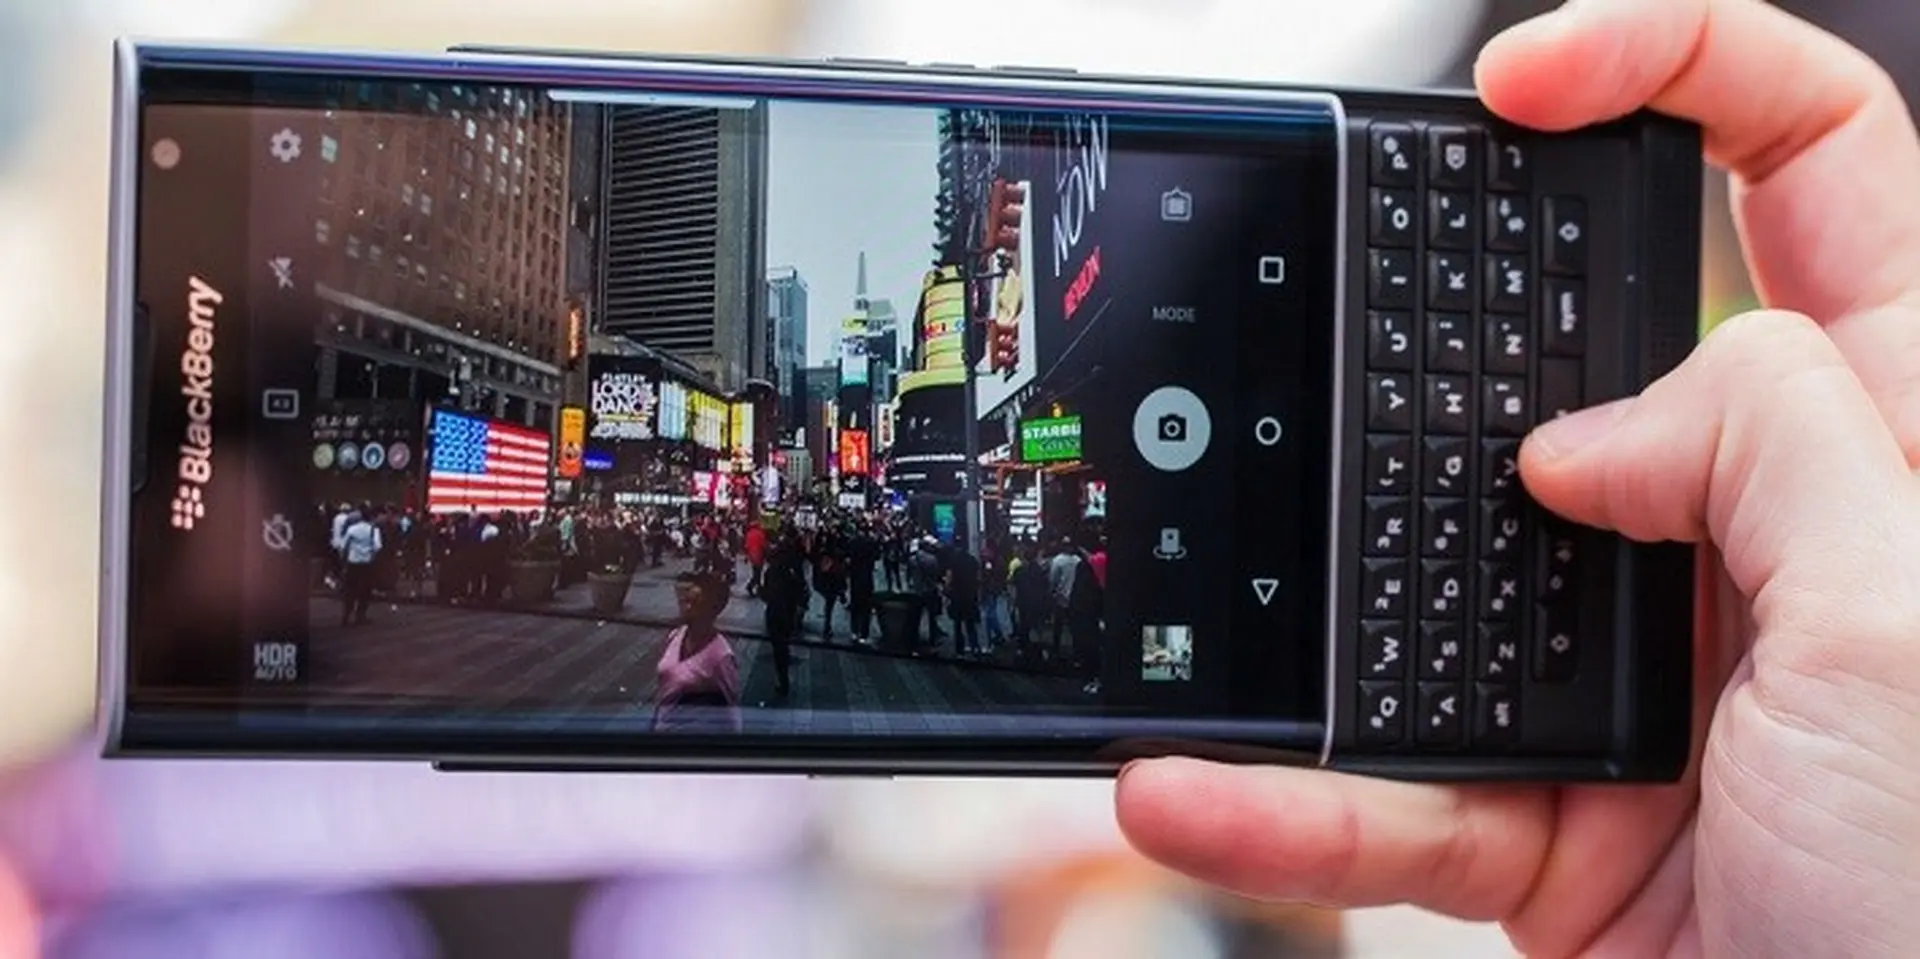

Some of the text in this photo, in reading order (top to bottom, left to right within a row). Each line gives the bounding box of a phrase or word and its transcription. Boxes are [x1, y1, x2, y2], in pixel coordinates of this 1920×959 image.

[1392, 154, 1408, 169] P
[1053, 115, 1108, 277] NOW
[1392, 207, 1409, 229] O
[1450, 214, 1465, 228] L
[1391, 276, 1406, 284] I
[1450, 273, 1465, 289] K
[1507, 270, 1523, 294] M
[1152, 306, 1196, 323] MODE
[1391, 333, 1407, 352] U
[1448, 339, 1463, 350] J
[1506, 335, 1522, 355] N
[179, 276, 223, 483] BlackBerry
[1389, 394, 1404, 409] Y
[1446, 394, 1462, 413] H
[1389, 458, 1403, 474] T
[1446, 456, 1461, 475] G
[1504, 458, 1517, 474] V
[1387, 518, 1402, 534] R
[1445, 520, 1459, 534] F
[1503, 519, 1518, 536] C
[1386, 580, 1400, 594] E
[1444, 579, 1459, 597] D
[1502, 581, 1516, 596] X
[254, 643, 297, 666] HDR
[1384, 637, 1398, 663] W
[1442, 641, 1457, 655] S
[1500, 643, 1515, 658] Z
[254, 666, 297, 680] AUTO
[1381, 696, 1398, 717] Q
[1441, 697, 1455, 715] A
[1495, 703, 1508, 726] alt
